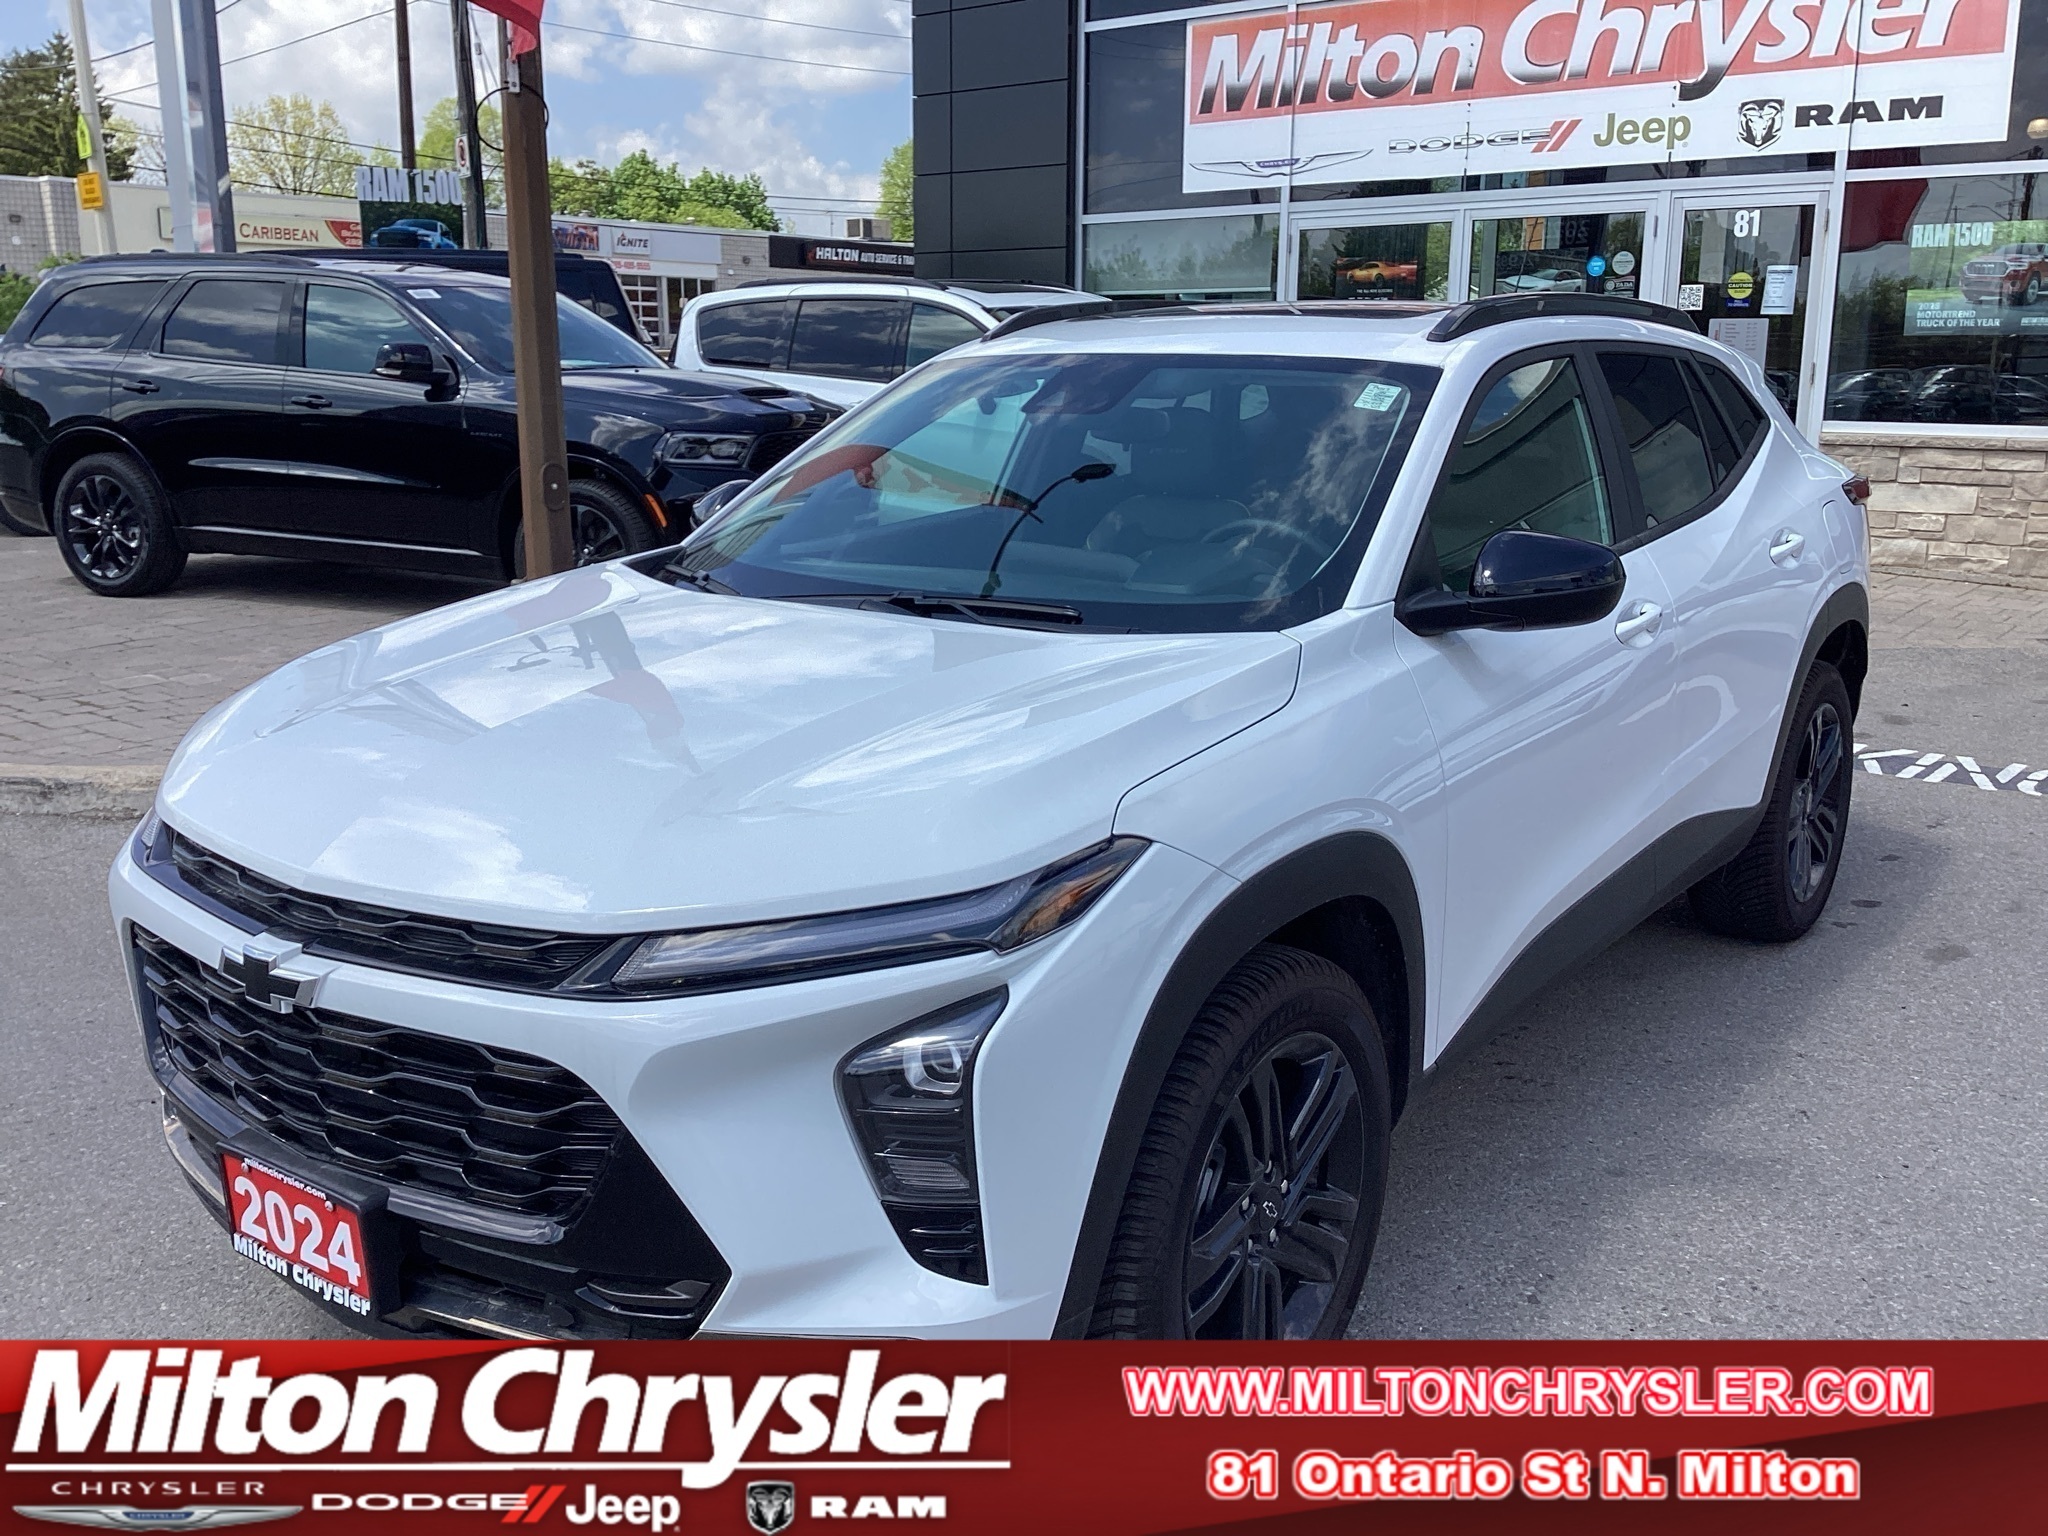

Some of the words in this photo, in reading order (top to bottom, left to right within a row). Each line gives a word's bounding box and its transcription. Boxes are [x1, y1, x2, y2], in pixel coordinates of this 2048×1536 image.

[1196, 21, 1486, 116] Milton
[1500, 0, 1965, 102] Chrysler
[1593, 112, 1691, 151] Jeep
[1794, 95, 1944, 128] RAM
[1388, 128, 1553, 154] DODGE
[357, 166, 410, 203] RAM
[414, 168, 463, 206] 1500
[239, 222, 320, 243] CARIBBEAN
[1733, 209, 1761, 238] 81
[1911, 223, 1951, 249] RAM
[1953, 221, 1994, 247] 1500
[616, 236, 649, 249] IGNITE
[815, 246, 860, 262] HALTON
[875, 253, 898, 265] SERVICE
[1916, 310, 1977, 319] MOTORTREND
[1916, 319, 1946, 327] TRUCK
[1946, 319, 1958, 327] OF
[1959, 319, 1976, 327] THE
[1977, 318, 2000, 327] YEAR
[233, 1175, 362, 1287] 2024
[233, 1232, 288, 1277] Milton
[292, 1263, 371, 1317] Chrysler
